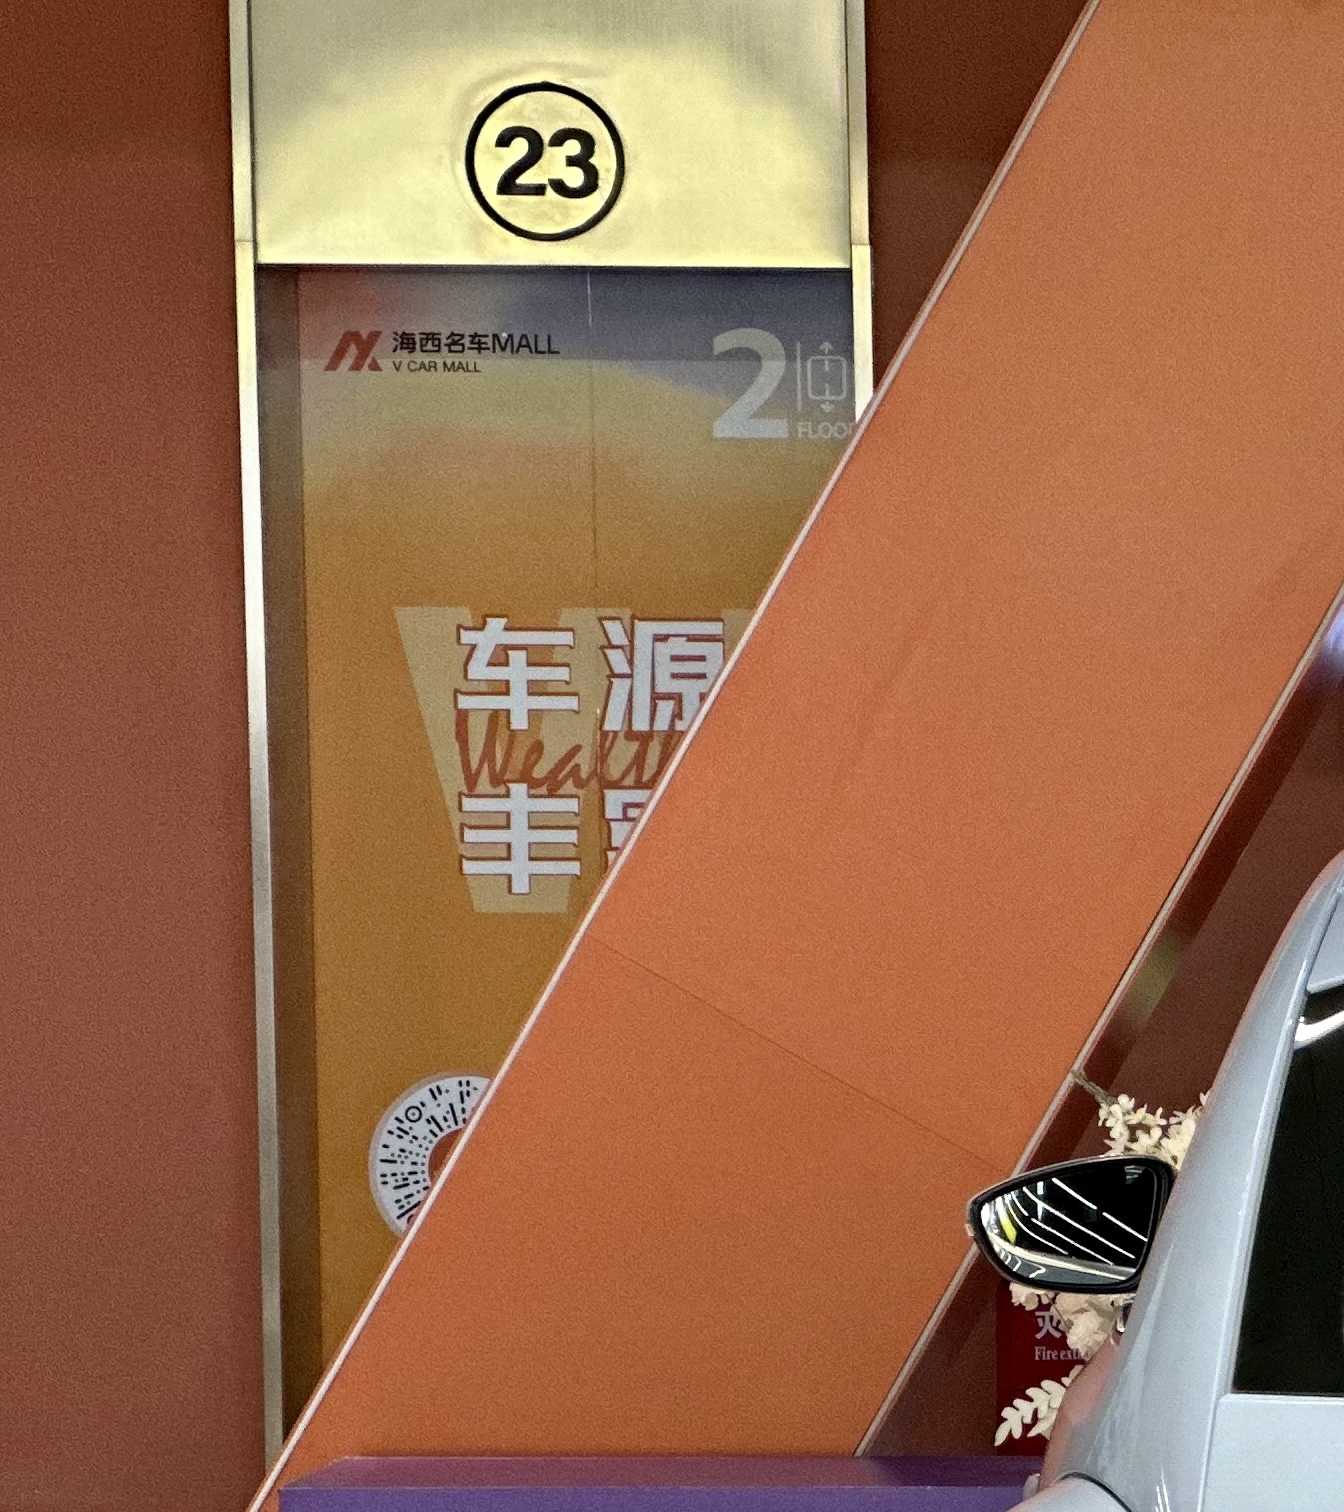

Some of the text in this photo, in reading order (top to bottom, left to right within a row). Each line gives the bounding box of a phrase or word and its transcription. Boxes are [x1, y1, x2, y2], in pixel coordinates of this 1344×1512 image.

[494, 126, 599, 199] 23
[392, 330, 560, 355] 海西名车MALL
[407, 360, 438, 373] CAR
[442, 360, 481, 373] MALL
[712, 327, 789, 439] 2
